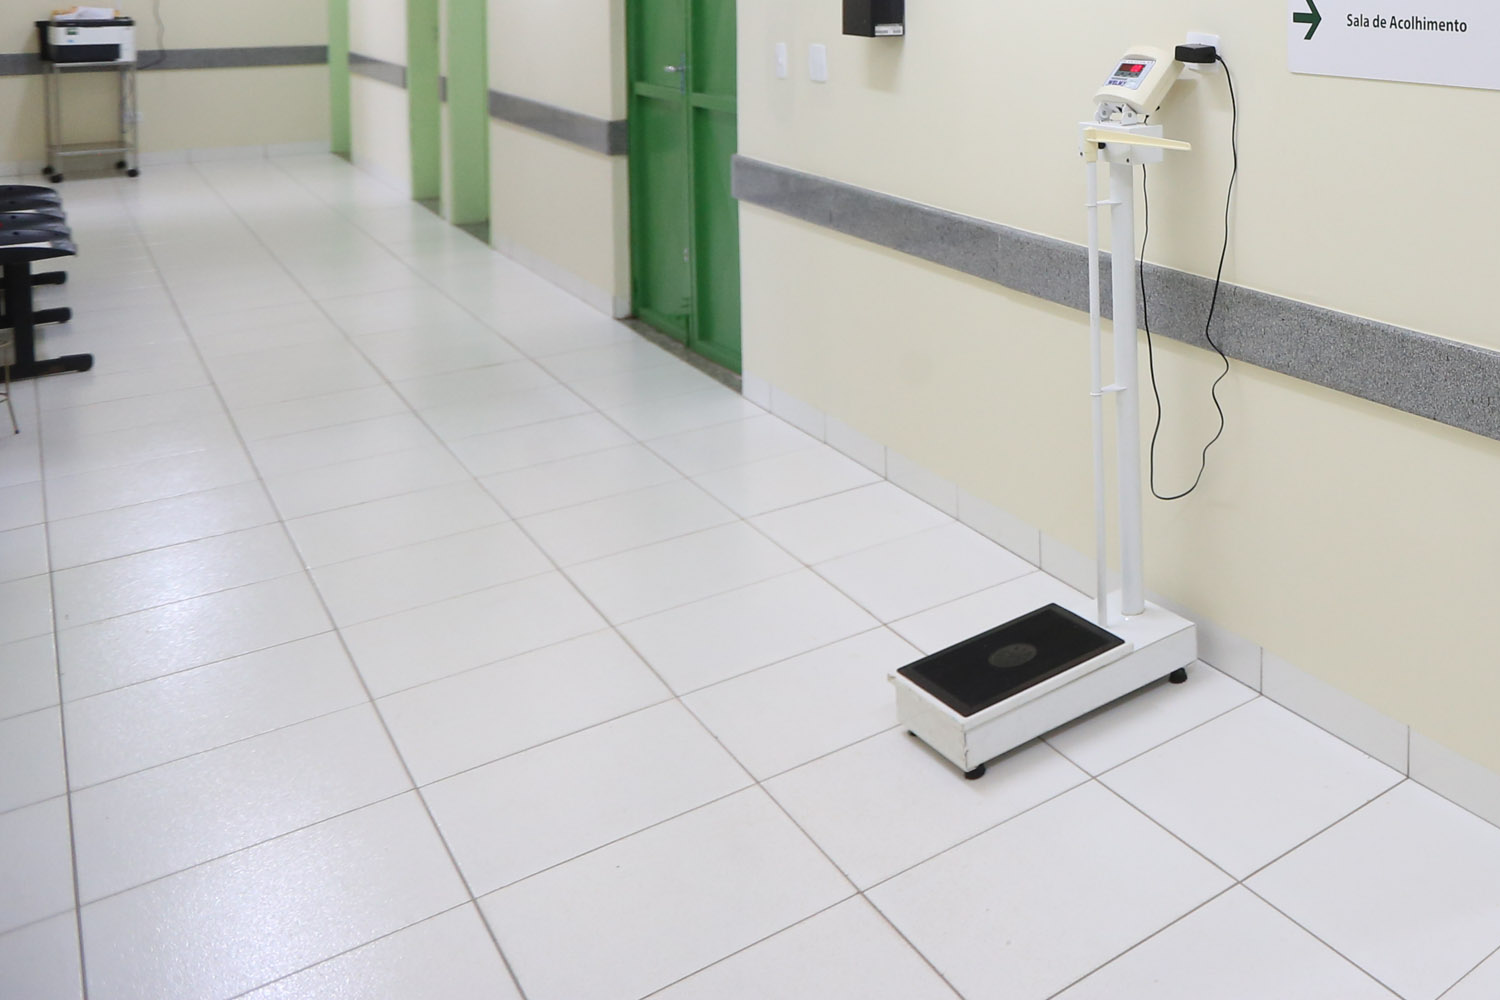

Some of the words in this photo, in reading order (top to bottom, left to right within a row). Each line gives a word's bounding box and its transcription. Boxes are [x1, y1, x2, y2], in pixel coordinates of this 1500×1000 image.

[1346, 13, 1370, 28] Sala
[1372, 15, 1387, 29] de
[1389, 16, 1468, 33] Acolhimento
